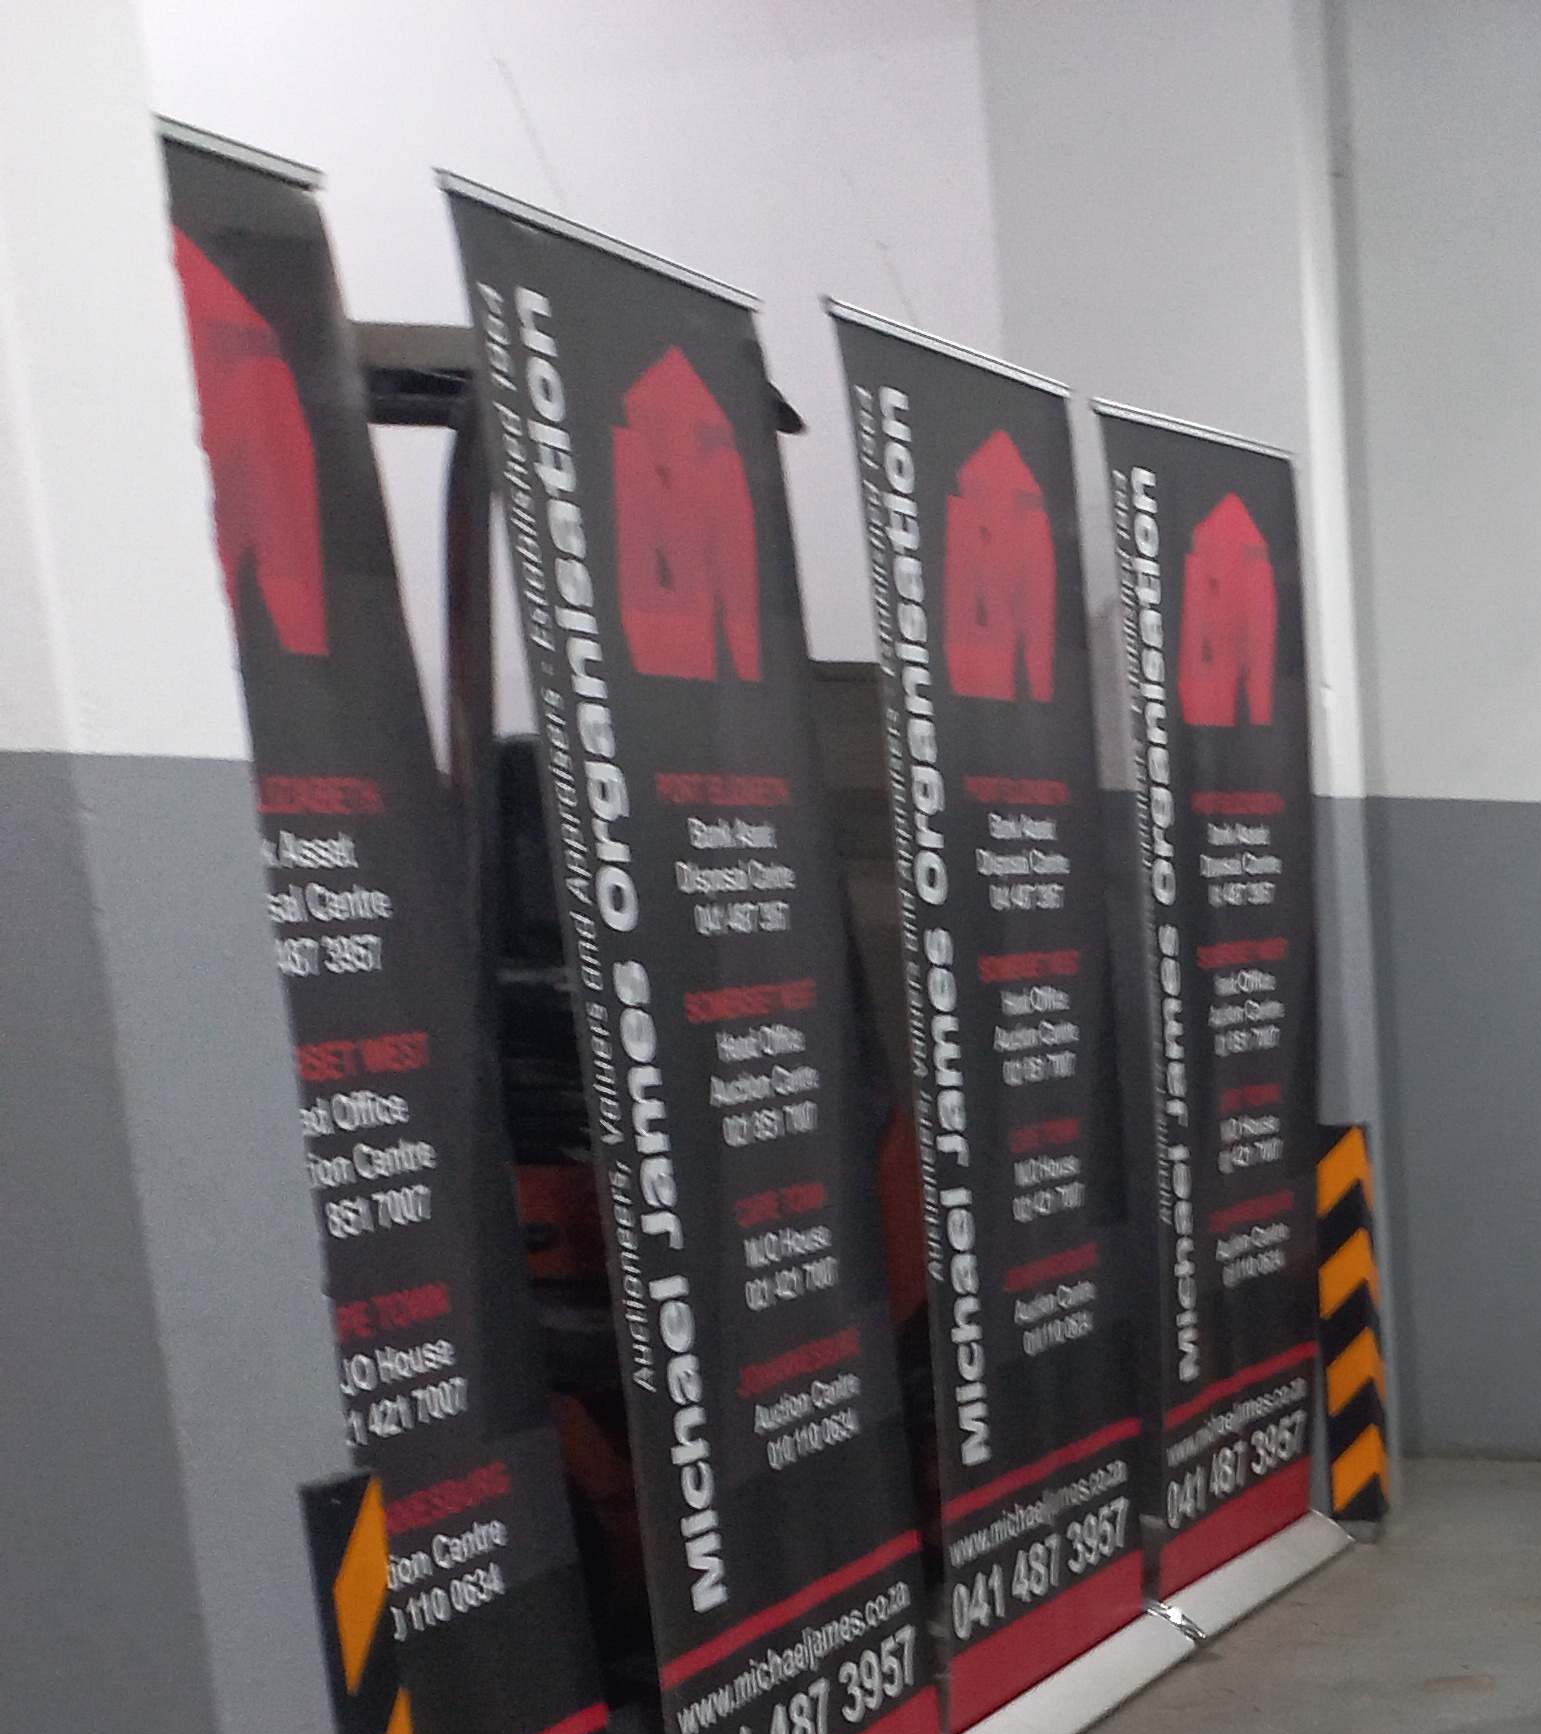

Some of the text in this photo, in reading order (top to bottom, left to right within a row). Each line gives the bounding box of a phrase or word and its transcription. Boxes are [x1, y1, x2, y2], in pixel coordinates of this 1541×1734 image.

[878, 384, 951, 906] Organisation
[1129, 465, 1177, 907] Organisation
[513, 285, 729, 1614] Michael James Organisation
[923, 926, 971, 1168] James
[1157, 923, 1189, 1128] James
[340, 1338, 456, 1397] JO House
[938, 1186, 993, 1467] Michael
[1166, 1143, 1201, 1383] Michael
[838, 1623, 917, 1724] 3957
[951, 1496, 1130, 1641] 041 487 3957
